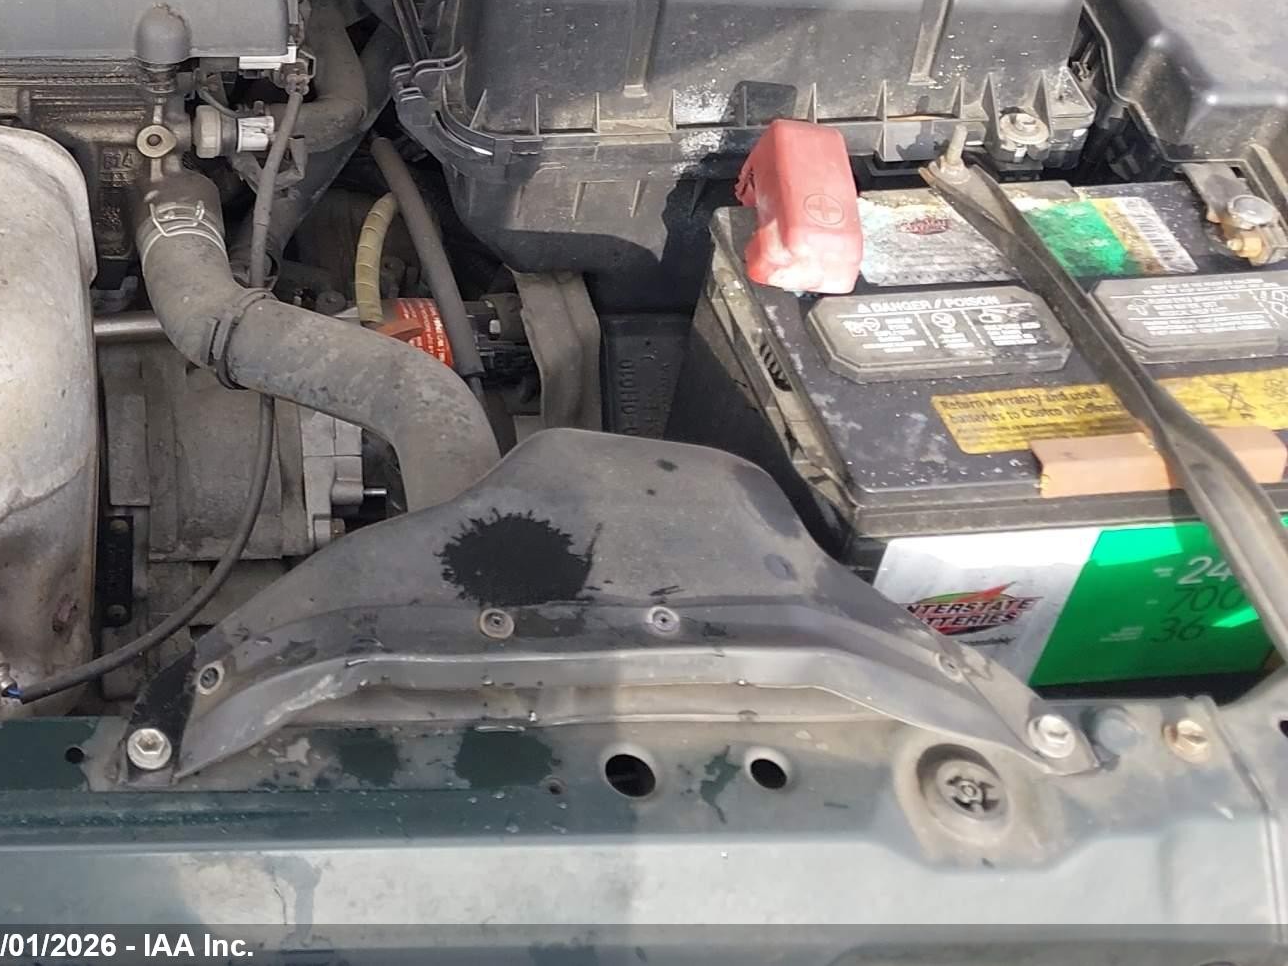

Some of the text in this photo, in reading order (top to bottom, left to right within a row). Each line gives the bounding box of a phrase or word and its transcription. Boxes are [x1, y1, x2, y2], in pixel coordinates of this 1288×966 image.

[870, 298, 932, 314] DANGER
[943, 295, 1001, 309] POISON
[984, 393, 1042, 407] warranty
[1045, 390, 1068, 403] and
[1070, 388, 1100, 400] used
[1006, 409, 1021, 421] to
[1022, 406, 1064, 419] Costco
[906, 598, 1035, 614] NTERSTATE
[925, 612, 1017, 626] TTERIES
